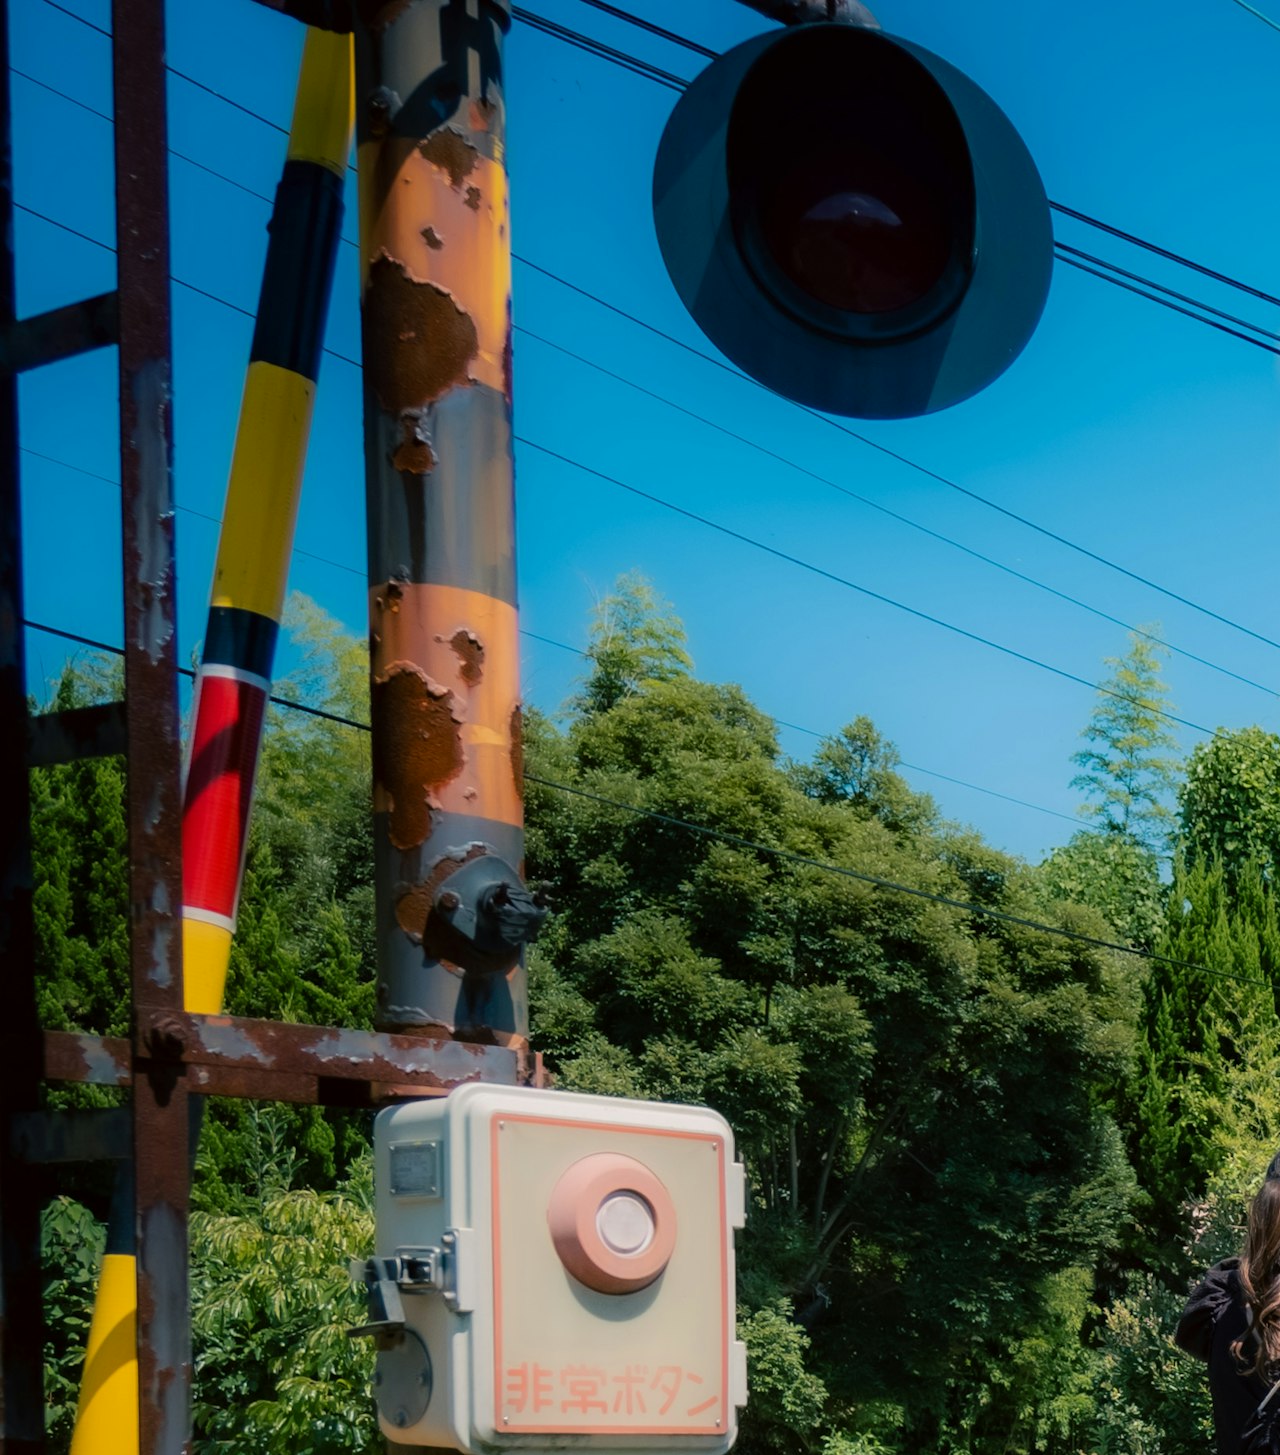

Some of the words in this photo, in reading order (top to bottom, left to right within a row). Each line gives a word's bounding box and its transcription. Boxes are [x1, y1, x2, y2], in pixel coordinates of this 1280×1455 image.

[506, 1361, 718, 1416] 非常ボタン
